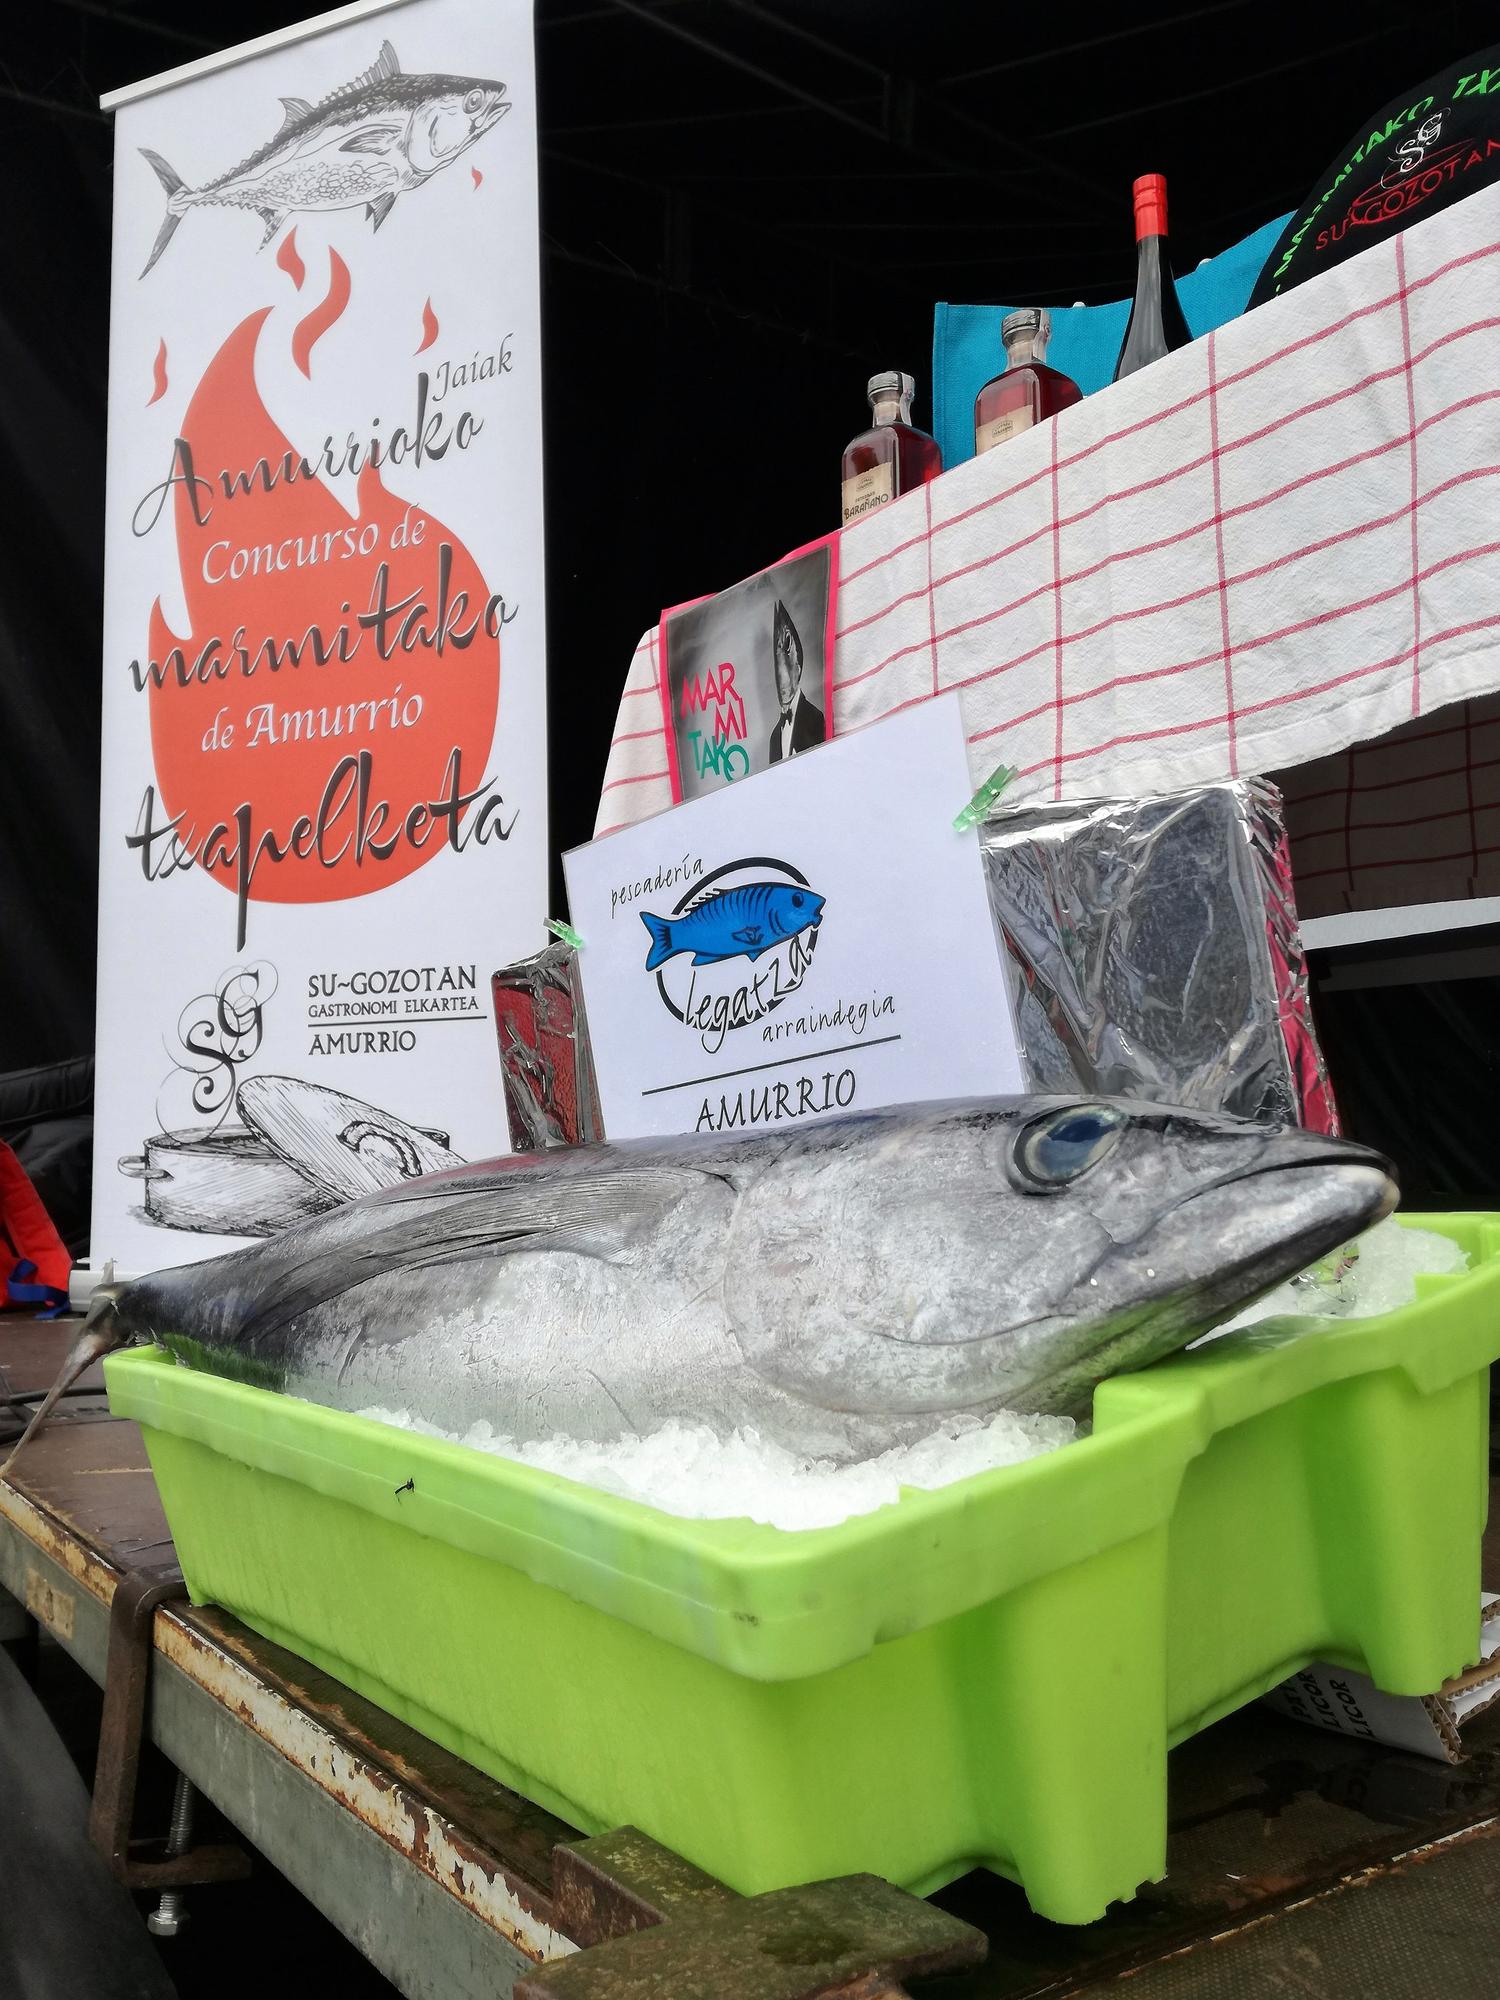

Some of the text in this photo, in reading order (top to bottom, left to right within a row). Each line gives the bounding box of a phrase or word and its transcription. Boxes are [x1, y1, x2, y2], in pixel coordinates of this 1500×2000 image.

[1452, 66, 1500, 99] TX
[432, 333, 514, 408] Jaiak
[132, 372, 485, 538] Amurrioko
[202, 502, 428, 585] Concurso de
[128, 543, 519, 693] marmitako
[680, 662, 742, 721] MAR
[201, 706, 235, 754] de
[124, 746, 521, 954] txapelketa
[610, 852, 704, 920] pescadería
[307, 995, 480, 1019] GASTRONOMI ELKARTEA
[761, 988, 897, 1044] arraindegia
[307, 1029, 417, 1057] AMURRIO
[694, 1068, 856, 1133] AMURRIO
[1329, 1678, 1377, 1739] LICOR
